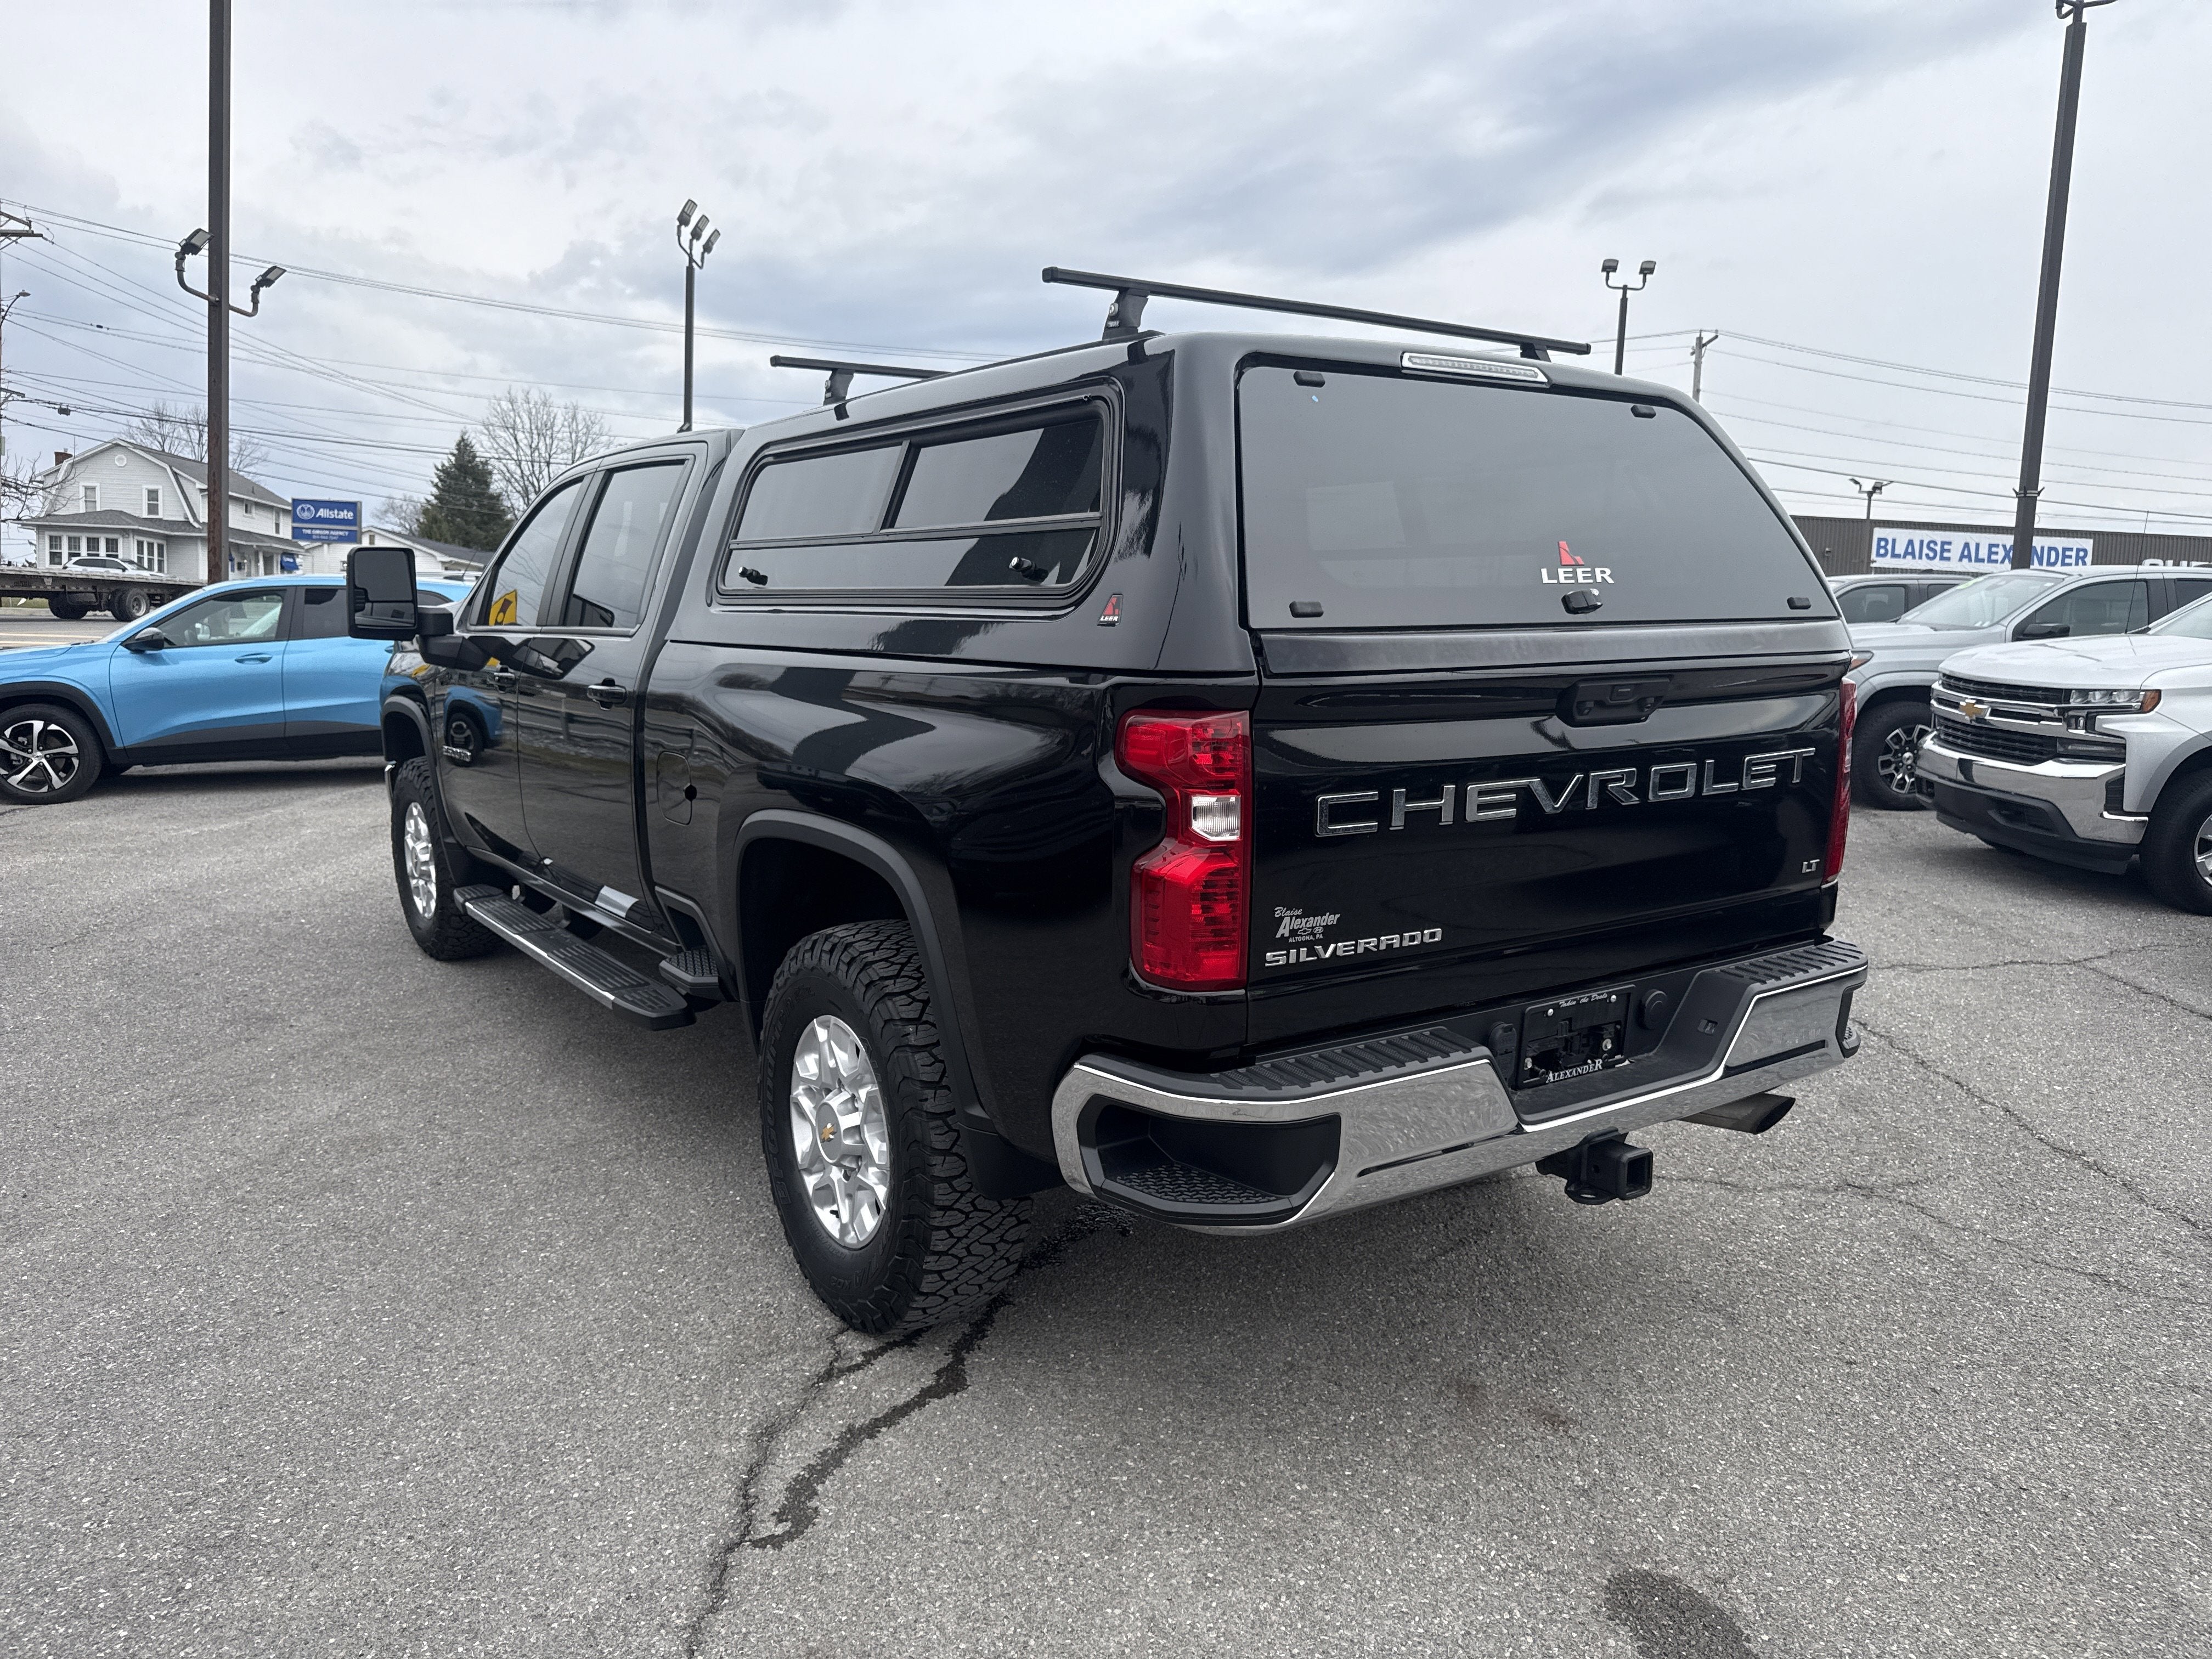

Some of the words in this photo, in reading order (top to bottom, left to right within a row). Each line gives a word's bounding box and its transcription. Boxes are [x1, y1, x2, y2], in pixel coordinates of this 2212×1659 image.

[315, 508, 354, 520] Allstate
[1875, 538, 1953, 561] BLAISE
[1958, 541, 2089, 567] ALEXNDER
[1541, 568, 1615, 584] LEER
[1316, 747, 1816, 837] CHEVROLET
[1801, 859, 1820, 873] LT
[1274, 906, 1302, 918] Blaise
[1275, 912, 1341, 938] Alexander
[1265, 928, 1442, 967] SILVERADO
[1288, 935, 1315, 943] ALTOONA,
[1545, 1058, 1602, 1084] ALEXANDER
